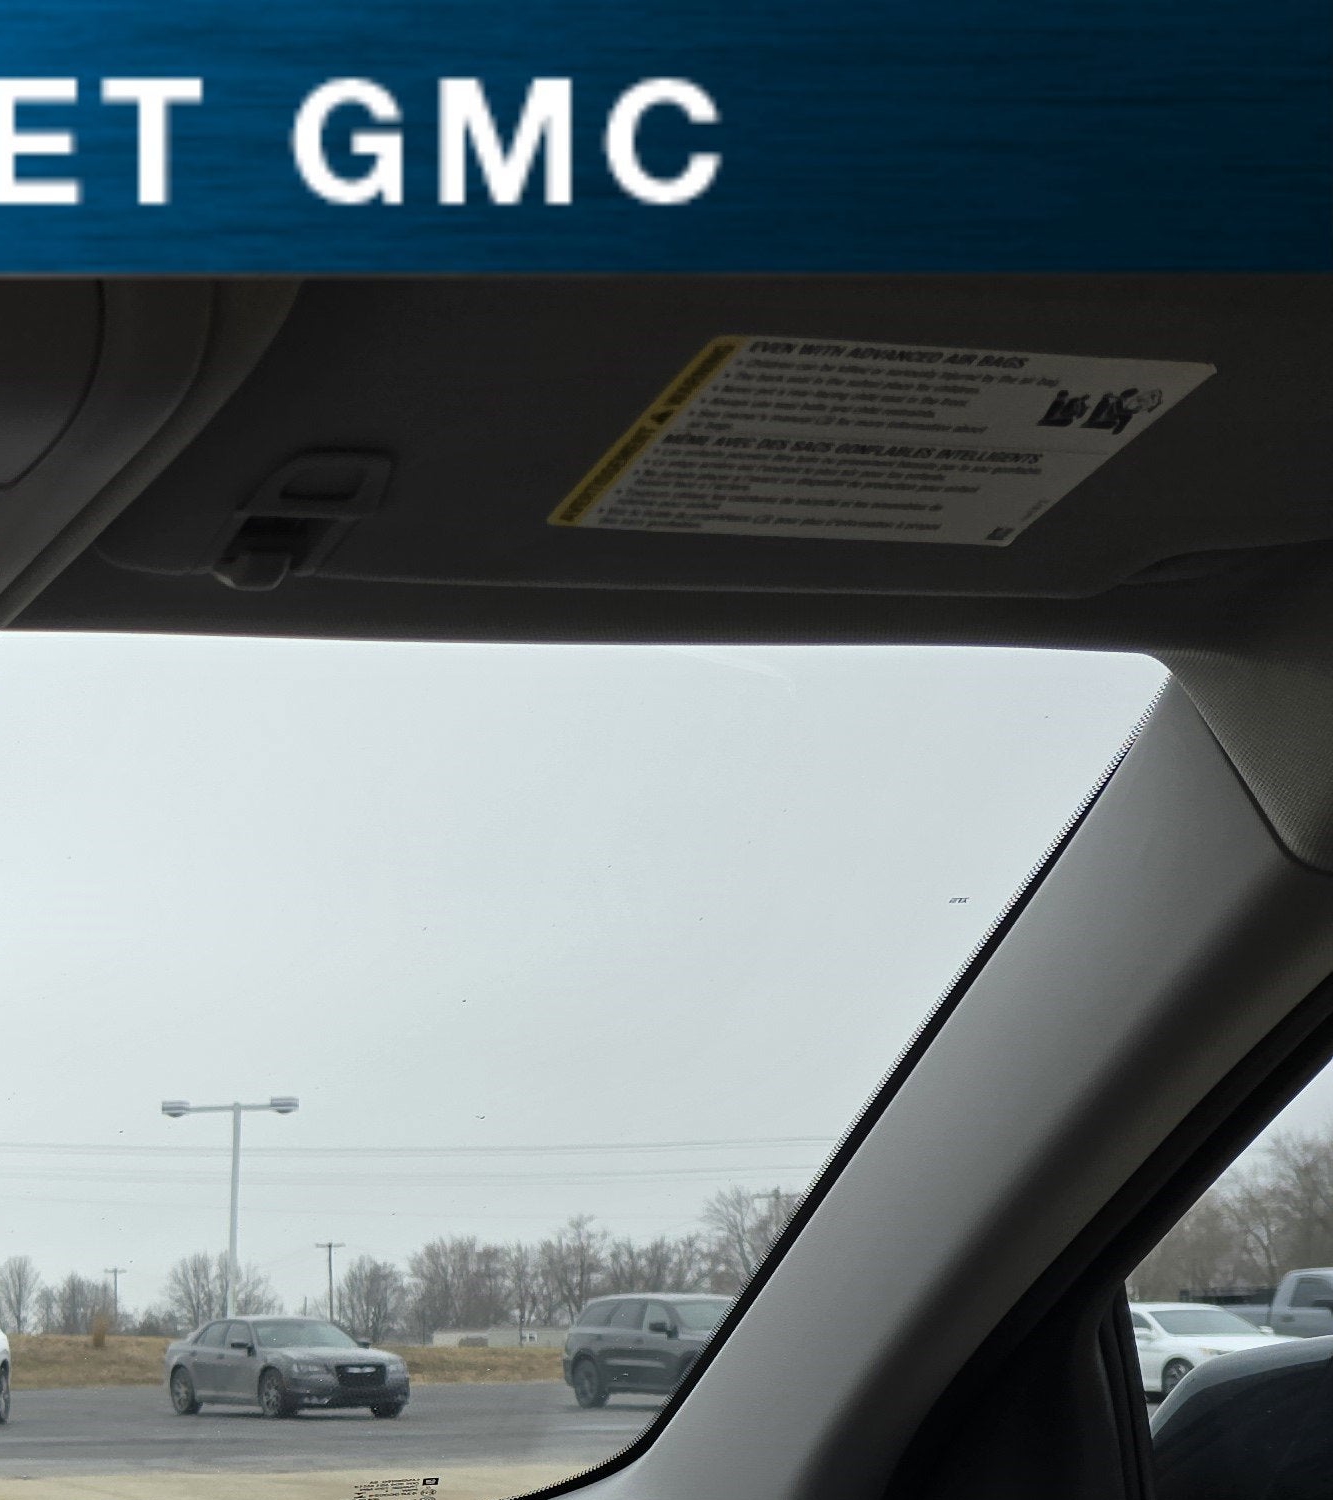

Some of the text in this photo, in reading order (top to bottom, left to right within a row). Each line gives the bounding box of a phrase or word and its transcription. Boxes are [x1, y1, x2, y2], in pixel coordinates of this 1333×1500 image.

[750, 341, 1029, 368] EVEN WITH ADVANCED AIR BAGS
